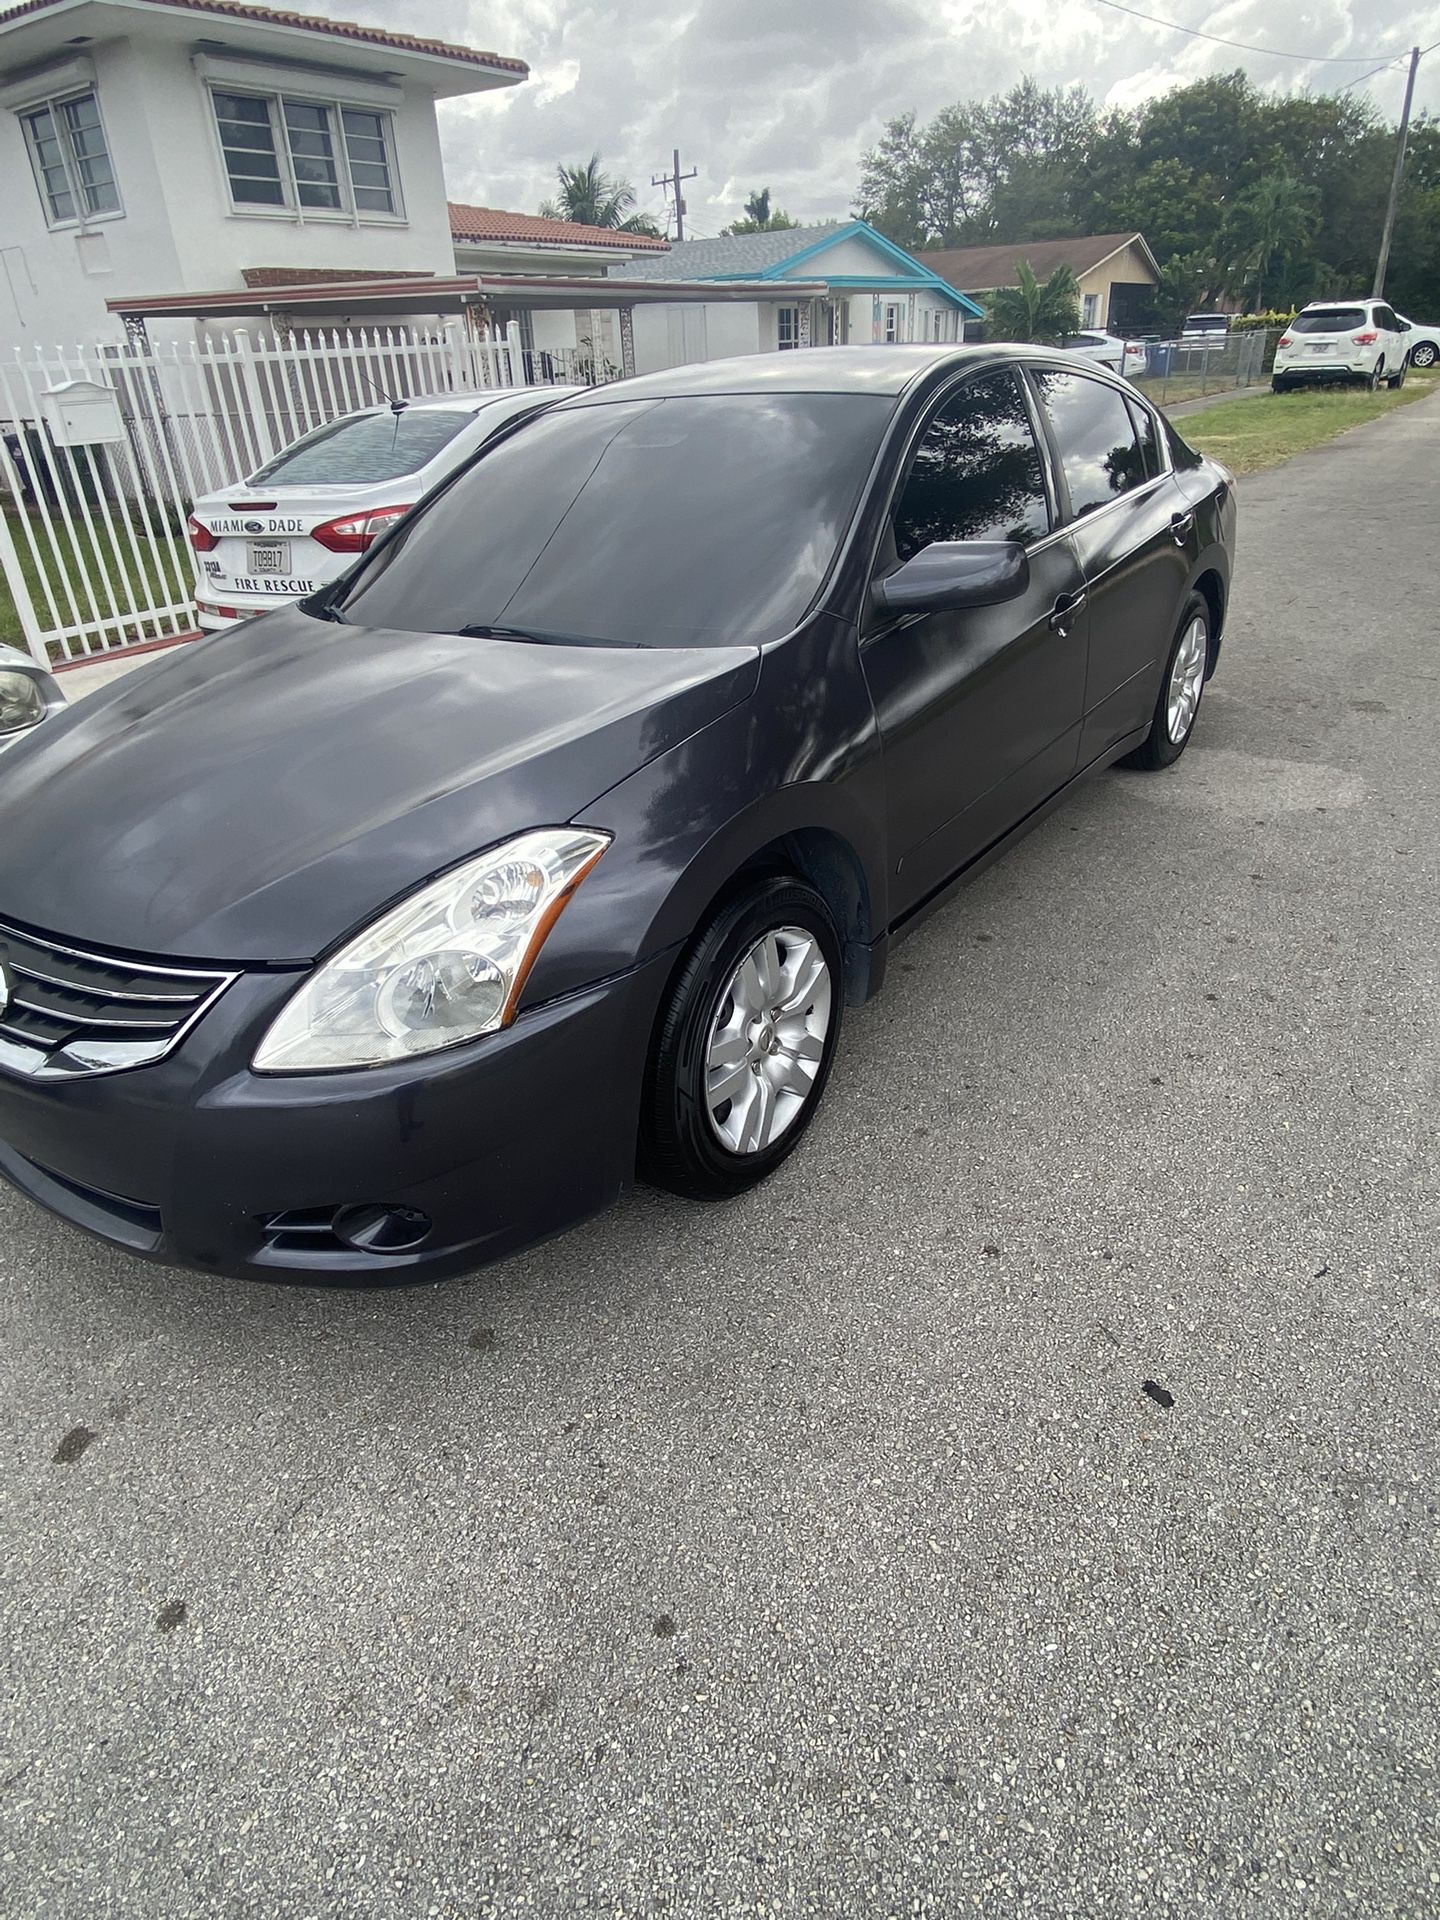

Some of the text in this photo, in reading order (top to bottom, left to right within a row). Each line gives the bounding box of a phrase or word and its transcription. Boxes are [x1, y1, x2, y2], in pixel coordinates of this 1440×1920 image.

[210, 520, 244, 533] MIAMI
[269, 519, 303, 532] DADE
[235, 578, 315, 593] FIRE RESCUE
